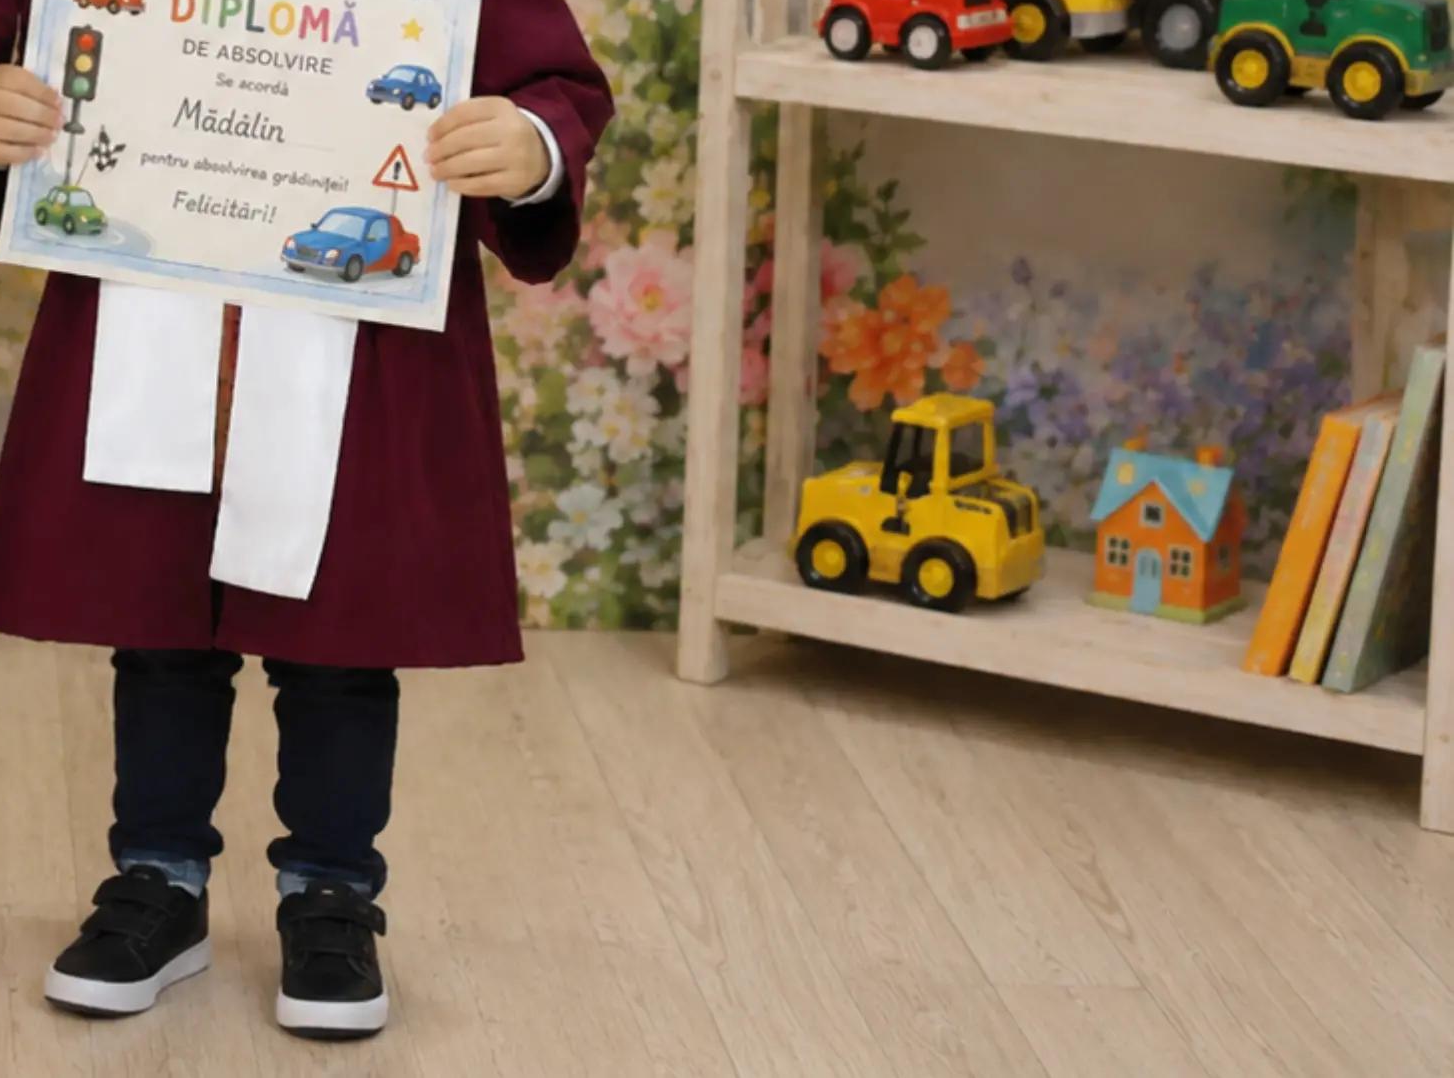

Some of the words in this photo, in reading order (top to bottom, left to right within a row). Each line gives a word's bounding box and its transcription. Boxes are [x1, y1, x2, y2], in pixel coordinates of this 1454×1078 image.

[182, 38, 210, 58] DE
[217, 44, 334, 75] ABSOLVIRE
[215, 72, 234, 88] Se
[238, 79, 290, 97] acordă
[141, 152, 189, 168] pentru
[194, 157, 268, 181] absolvirea
